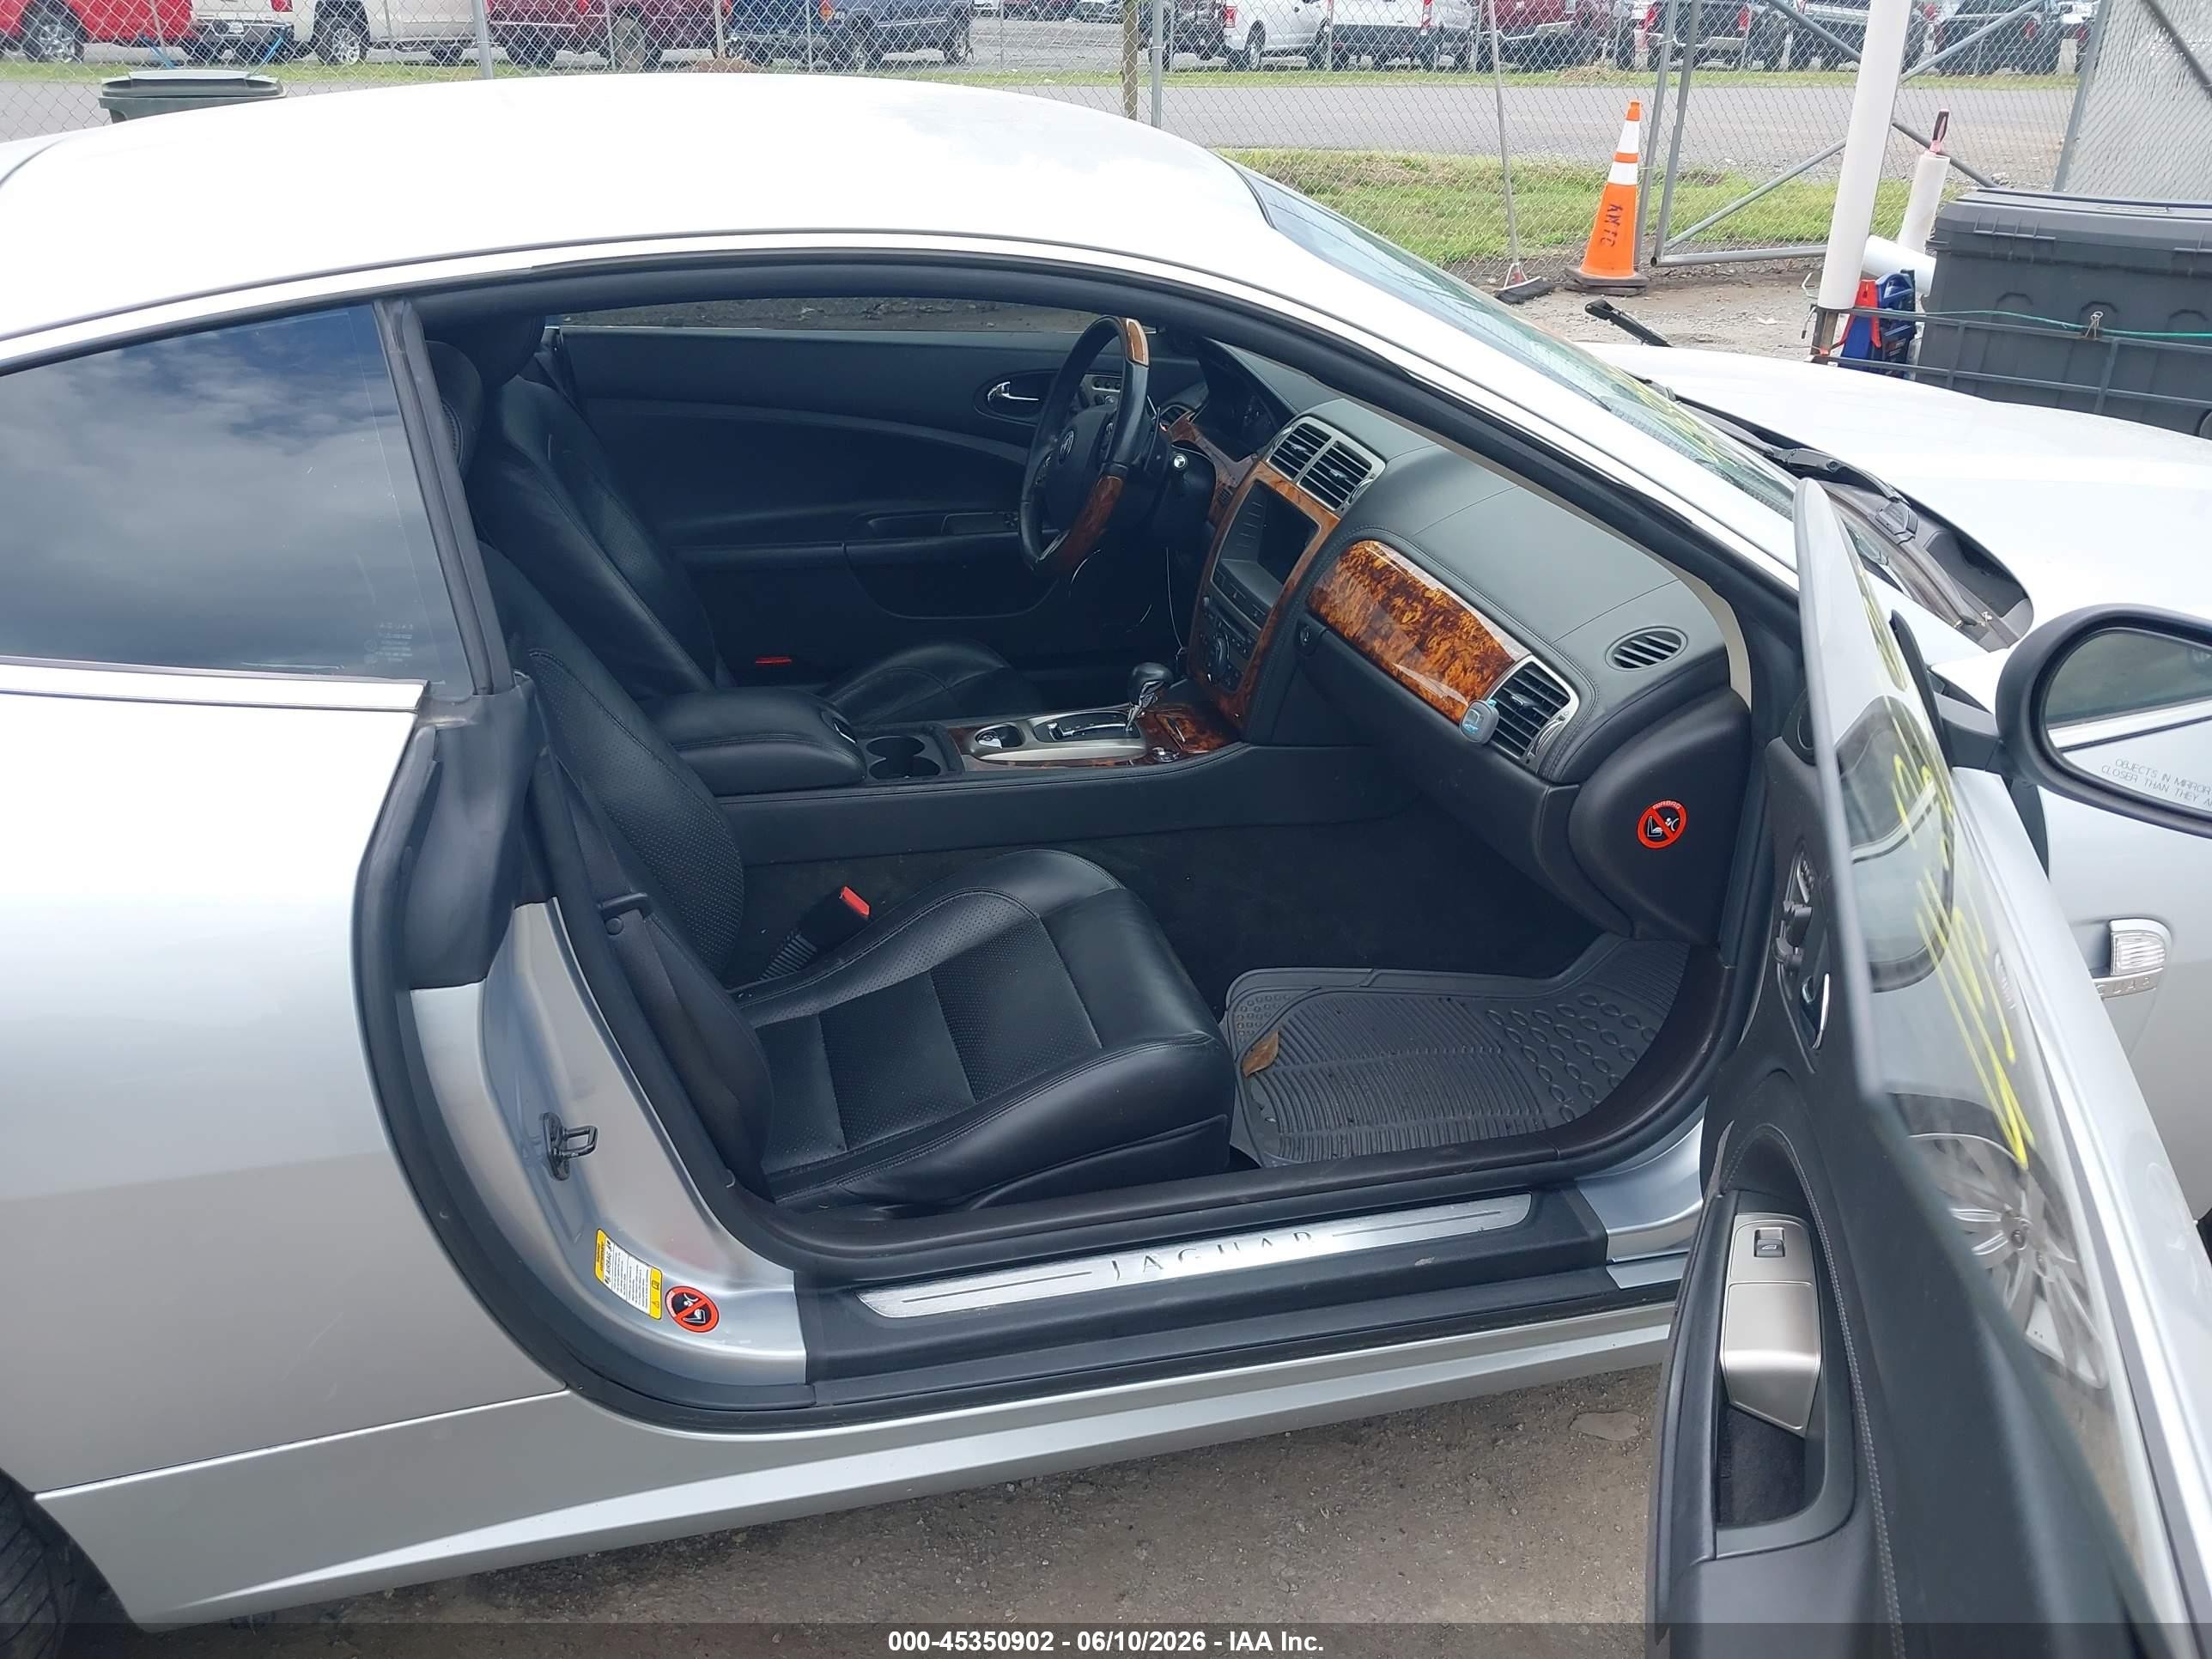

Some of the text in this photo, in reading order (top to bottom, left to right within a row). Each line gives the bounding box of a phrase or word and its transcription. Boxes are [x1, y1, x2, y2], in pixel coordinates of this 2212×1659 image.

[2101, 764, 2139, 783] CLOSER
[2144, 778, 2170, 793] THAN
[2174, 788, 2199, 802] THEY
[2115, 758, 2159, 779] OBJECTS
[2160, 773, 2172, 782] IN
[1110, 1231, 1314, 1282] JAGUAR
